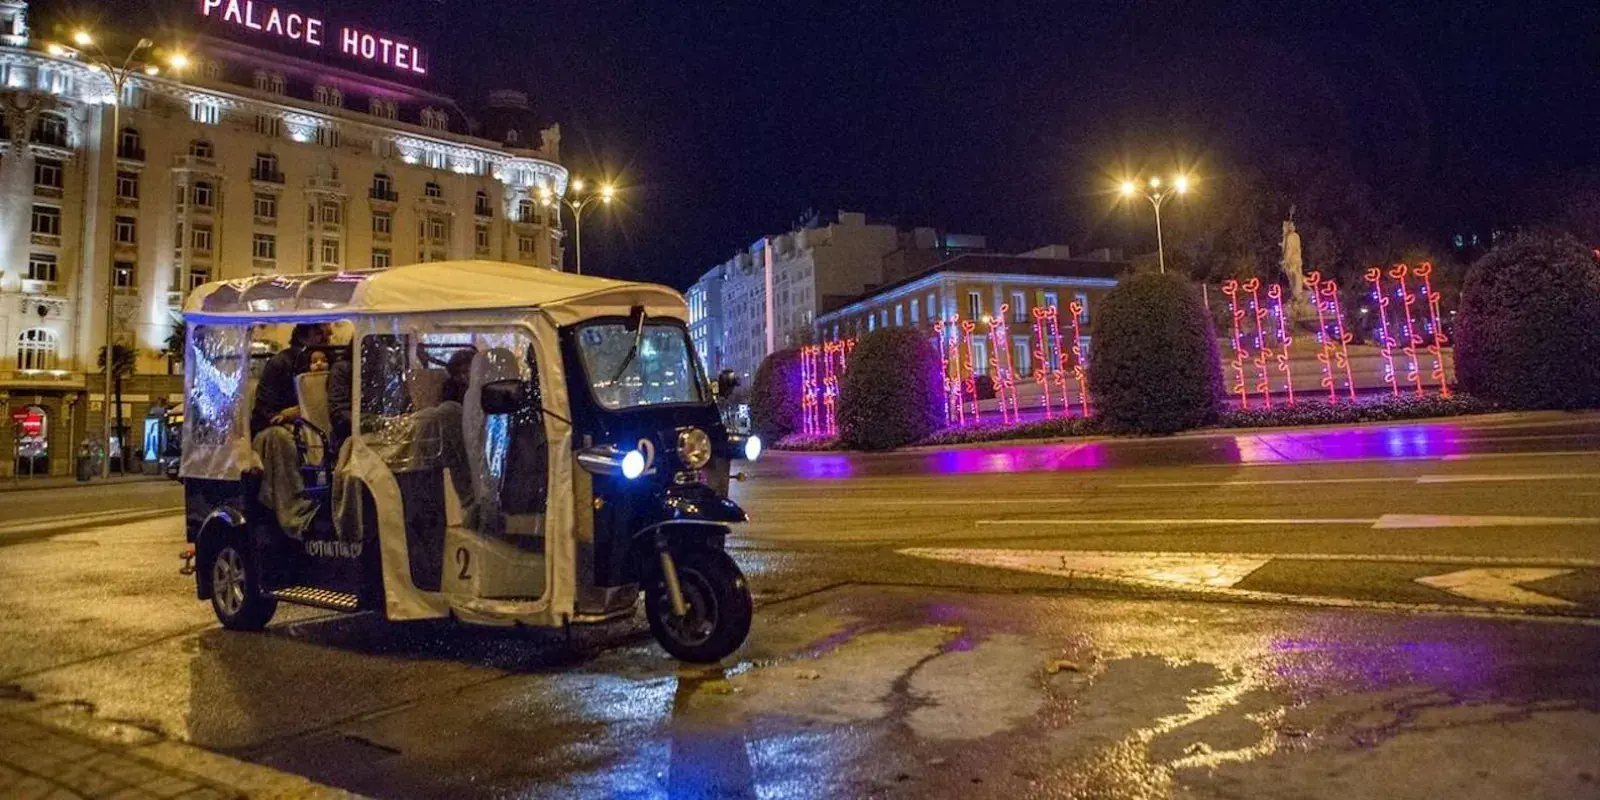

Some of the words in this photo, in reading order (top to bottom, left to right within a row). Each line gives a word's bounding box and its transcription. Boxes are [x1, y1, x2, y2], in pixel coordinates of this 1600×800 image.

[203, 0, 322, 46] PALACE
[342, 27, 425, 74] HOTEL
[637, 438, 657, 476] 2
[456, 547, 472, 580] 2
